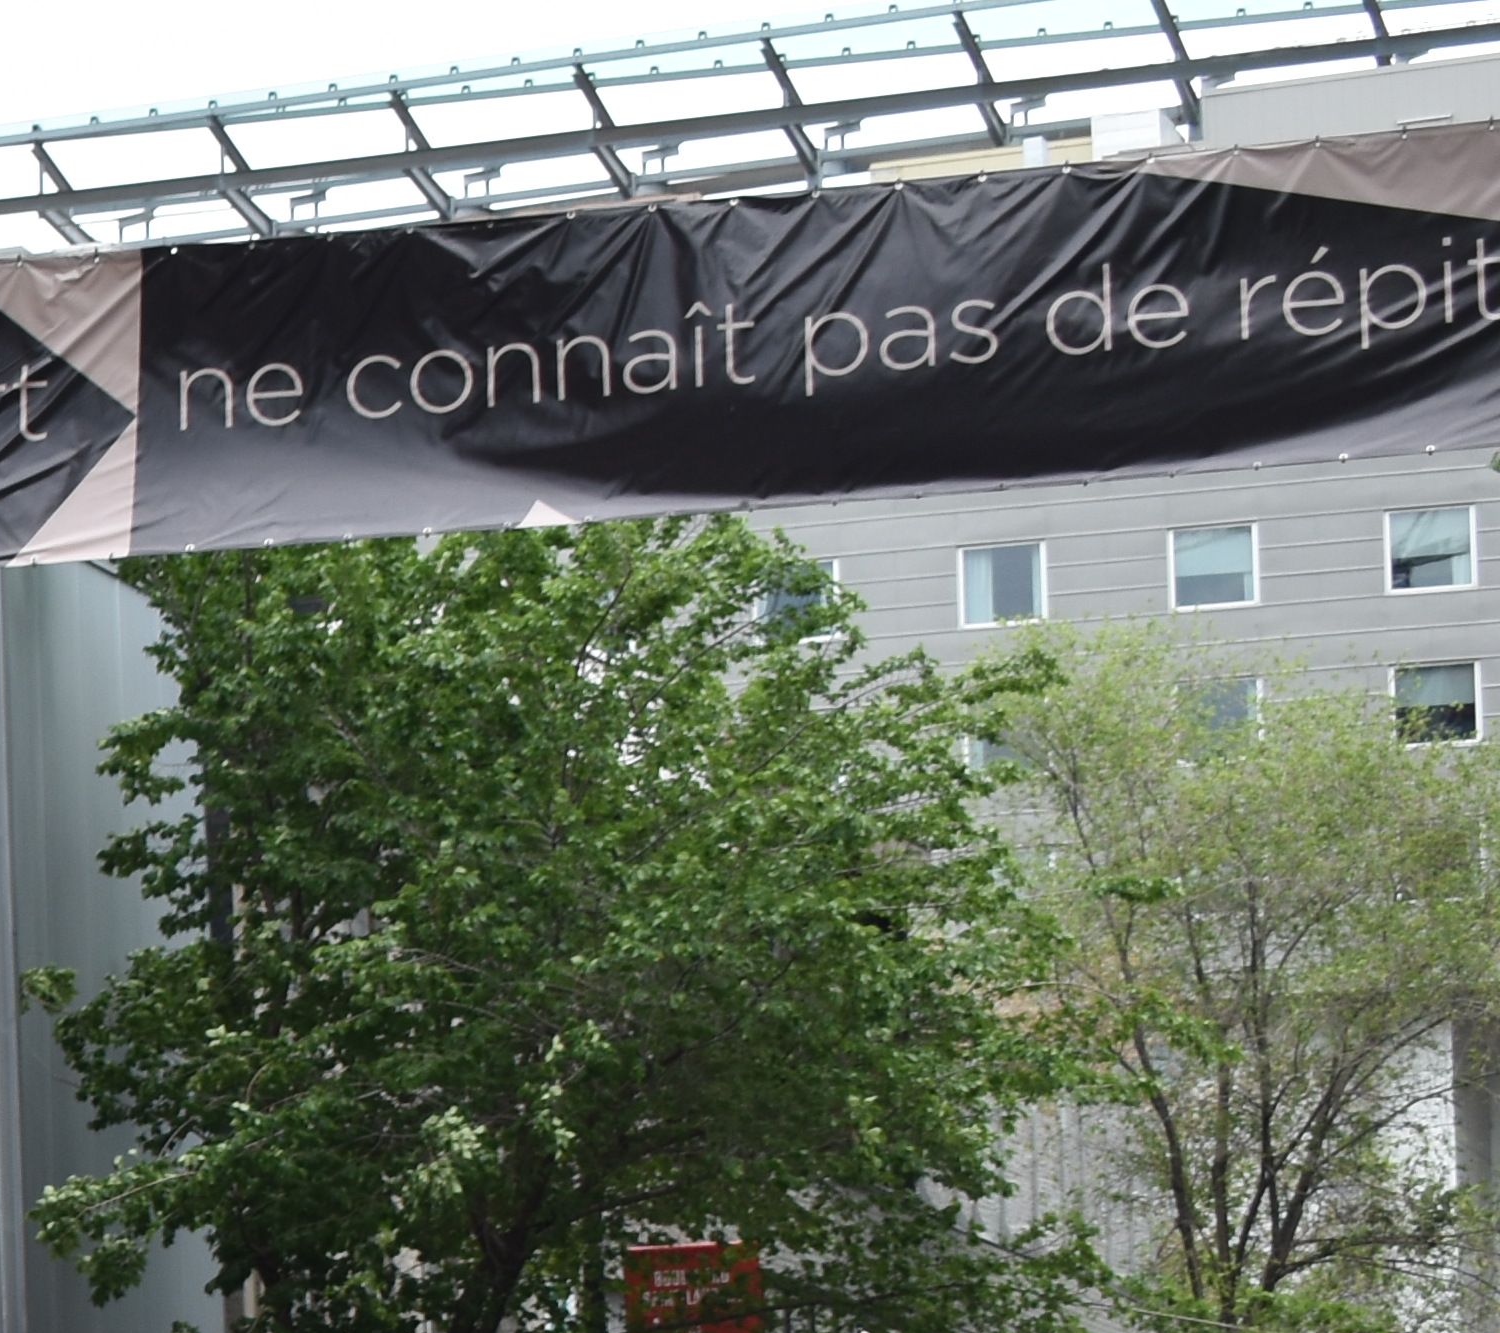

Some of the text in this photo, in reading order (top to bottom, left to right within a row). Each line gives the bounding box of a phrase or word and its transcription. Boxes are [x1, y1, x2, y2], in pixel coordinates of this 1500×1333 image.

[178, 359, 305, 433] ne
[347, 299, 755, 422] connaît
[804, 297, 1001, 398] pas
[1046, 264, 1191, 354] de
[1240, 236, 1500, 350] répit
